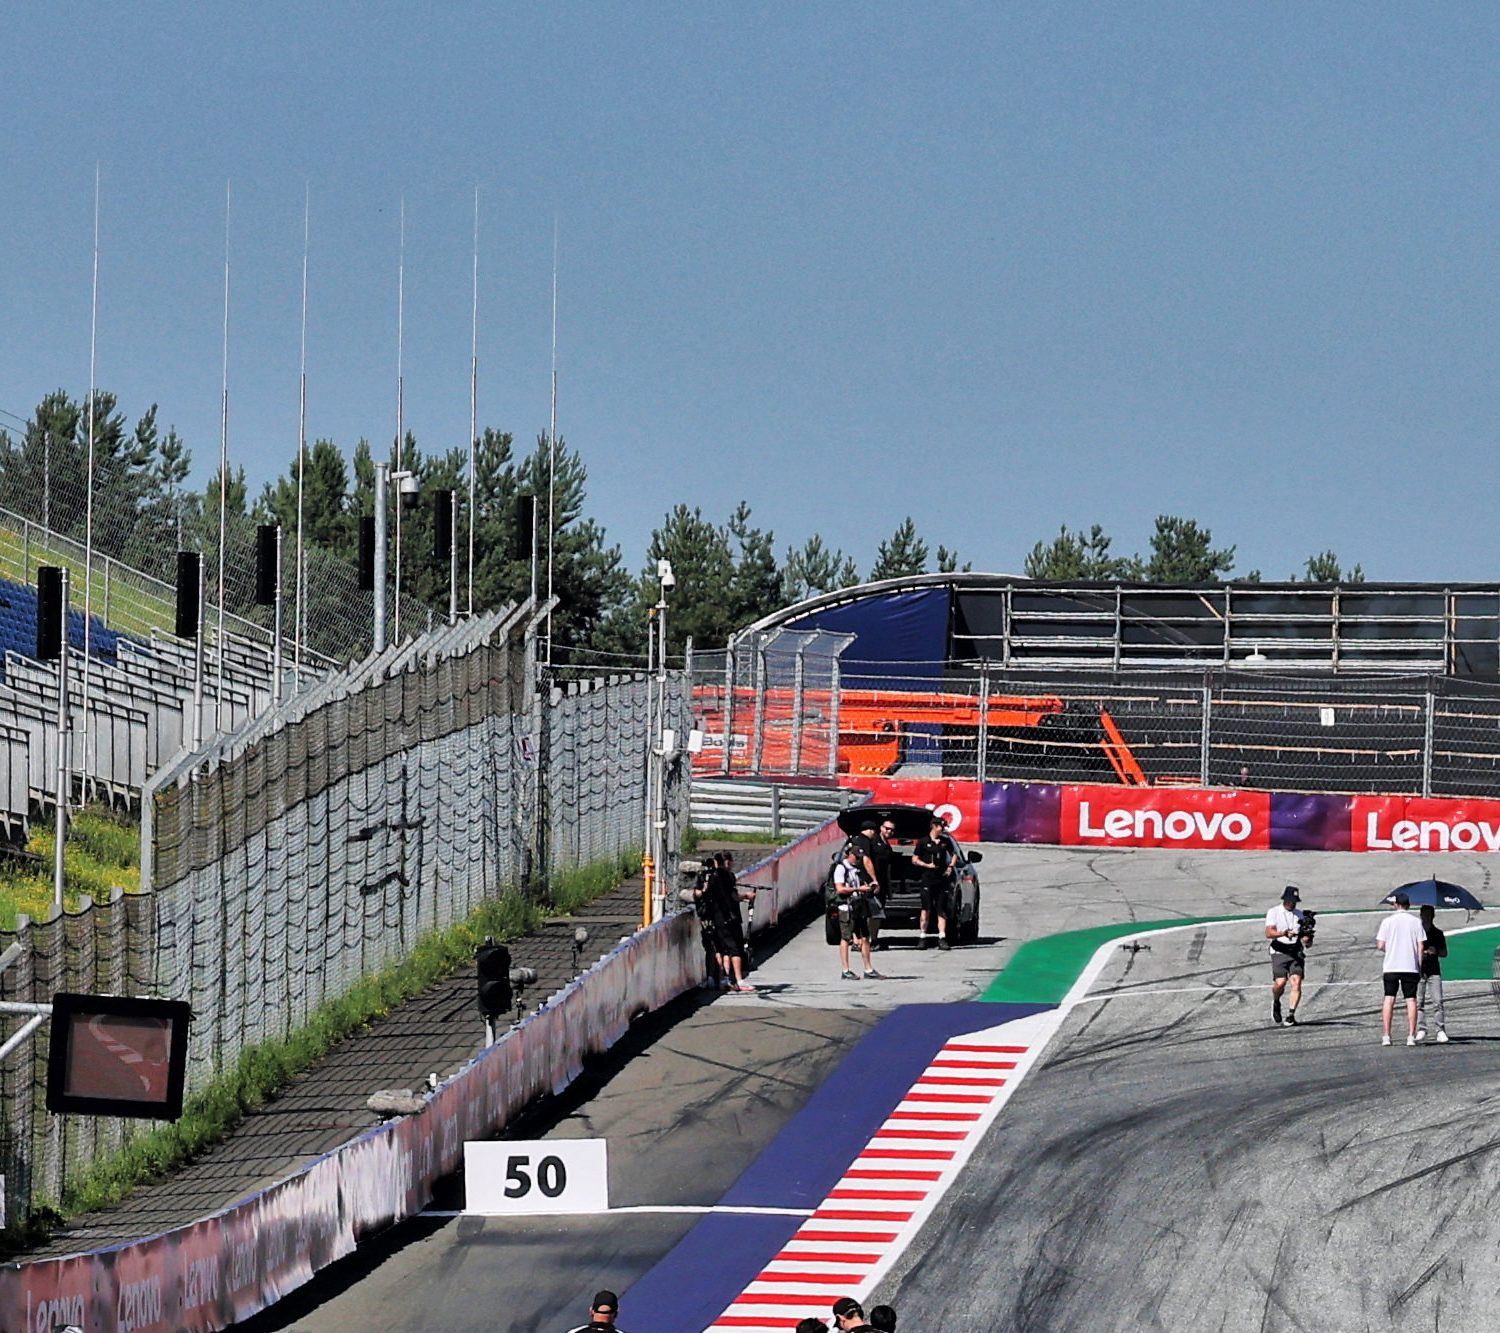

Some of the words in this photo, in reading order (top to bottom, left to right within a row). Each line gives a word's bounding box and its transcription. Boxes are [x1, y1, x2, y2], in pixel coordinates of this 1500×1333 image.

[1079, 801, 1252, 841] Lenovo
[503, 1155, 567, 1199] 50
[117, 1274, 161, 1333] Lenovo
